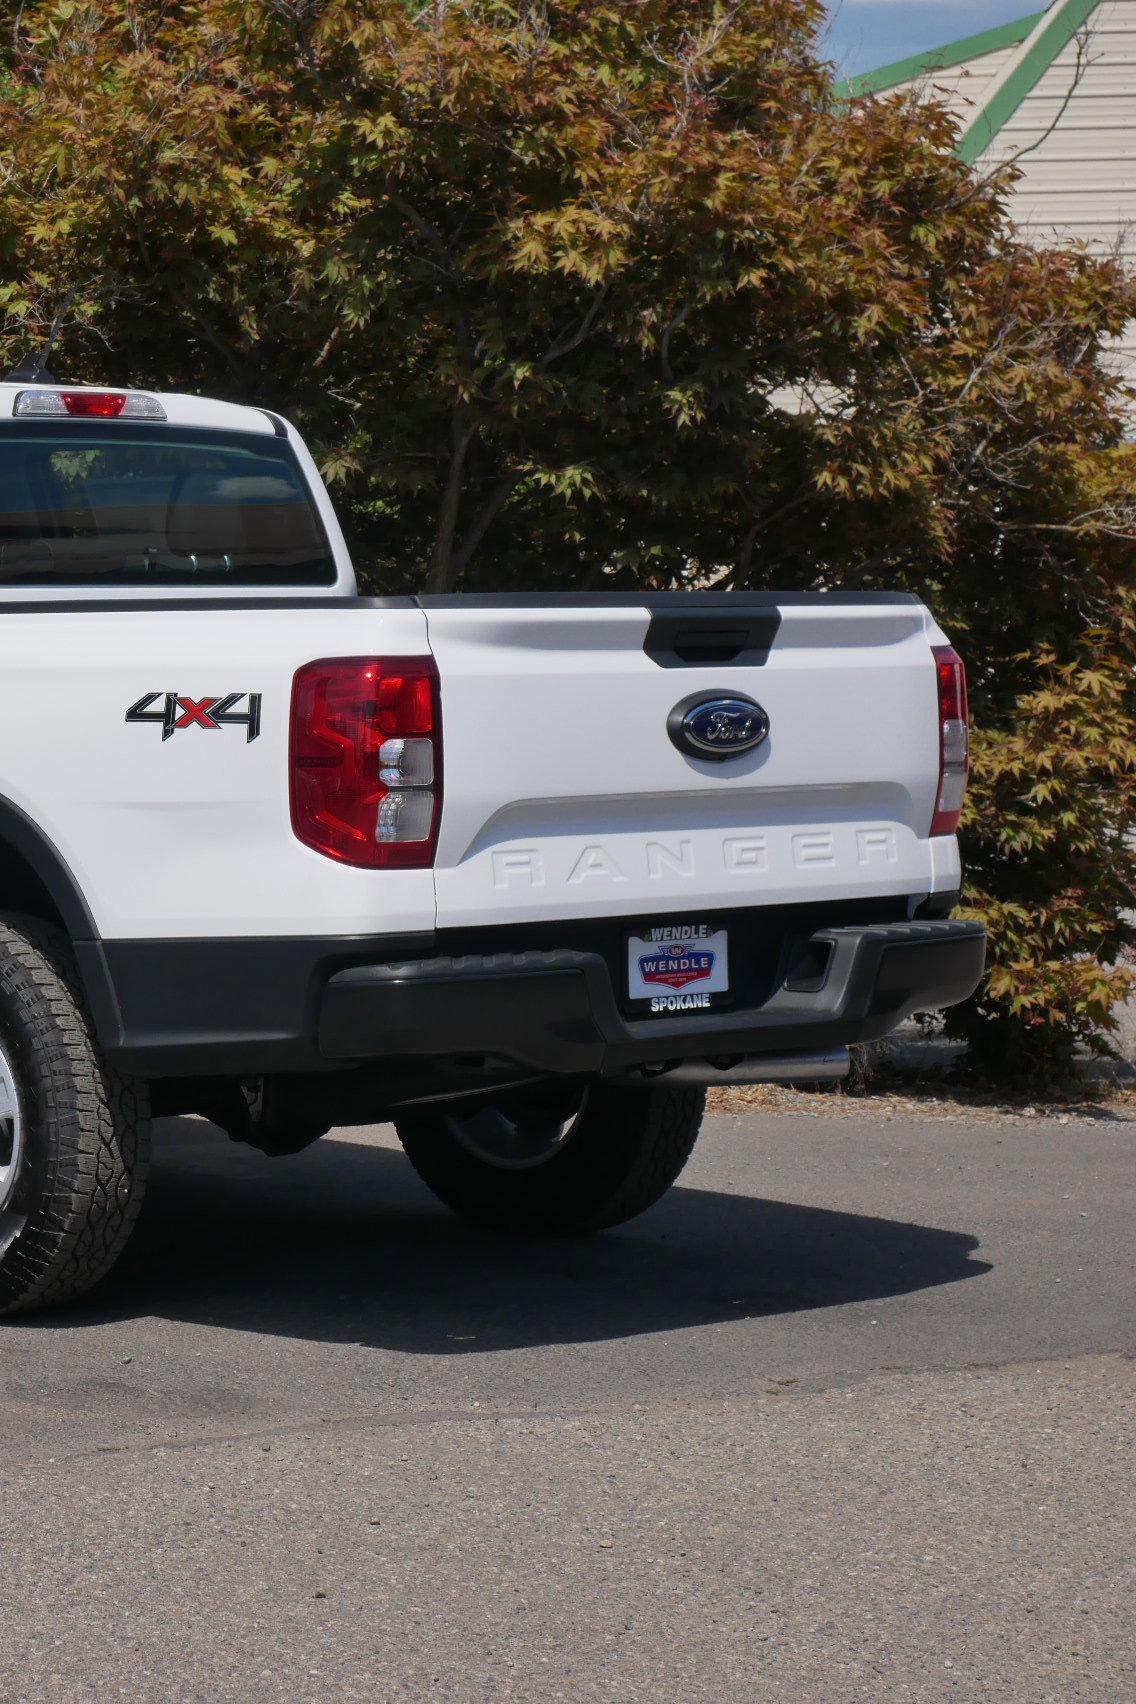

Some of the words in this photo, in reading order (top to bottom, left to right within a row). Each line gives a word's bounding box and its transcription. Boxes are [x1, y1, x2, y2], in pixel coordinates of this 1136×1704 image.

[707, 711, 752, 740] Ford
[491, 827, 898, 889] RANGER
[651, 925, 708, 942] WENDLE
[644, 957, 709, 972] WENDLE
[651, 993, 710, 1012] SPOKANE
